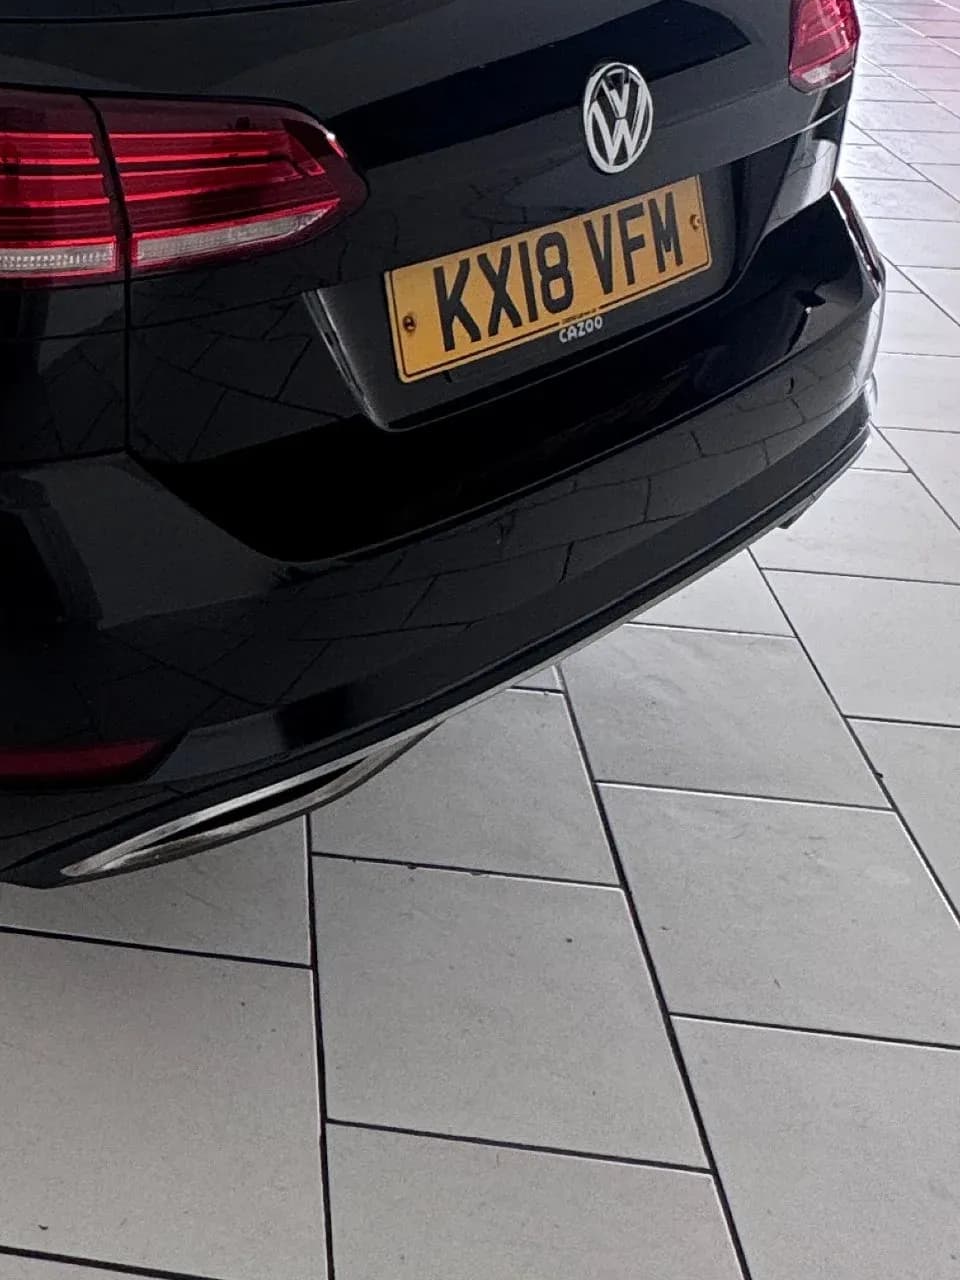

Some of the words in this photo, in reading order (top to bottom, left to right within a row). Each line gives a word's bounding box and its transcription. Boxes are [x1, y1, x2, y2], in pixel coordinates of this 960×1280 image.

[584, 63, 652, 173] VW
[434, 231, 573, 351] KX18
[583, 192, 683, 295] VFM
[559, 316, 603, 343] CAZOO
